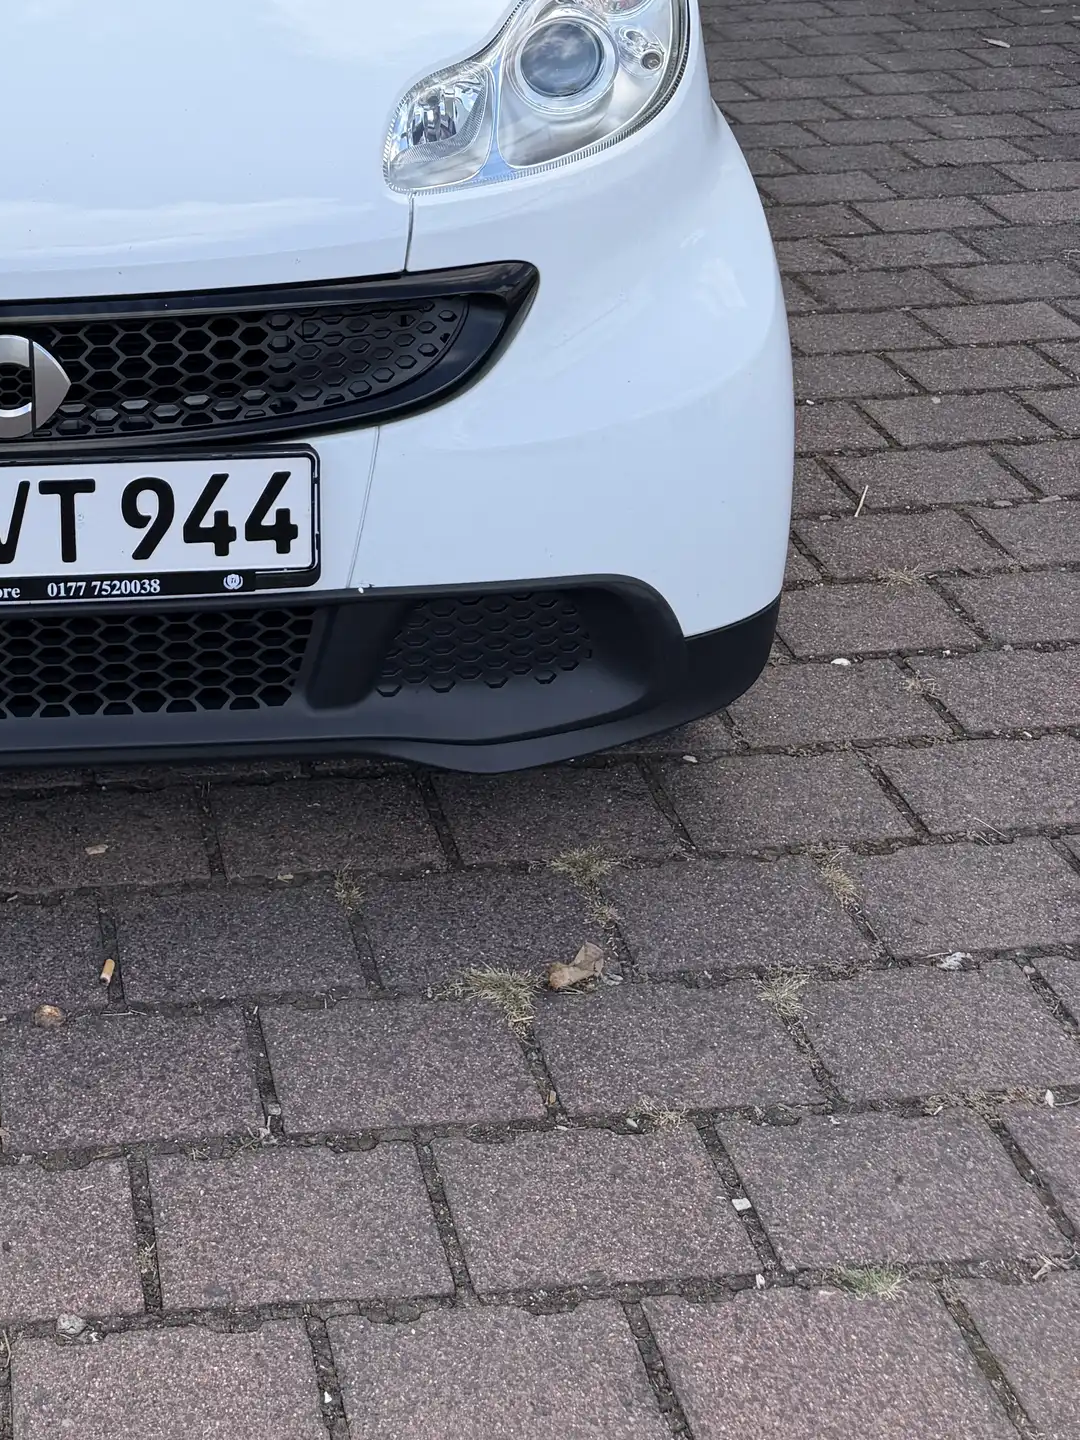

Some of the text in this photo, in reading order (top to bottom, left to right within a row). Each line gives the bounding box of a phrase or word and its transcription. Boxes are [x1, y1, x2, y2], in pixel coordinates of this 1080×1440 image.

[121, 471, 299, 561] 944
[47, 581, 86, 597] 0177
[91, 578, 161, 595] 7520038
